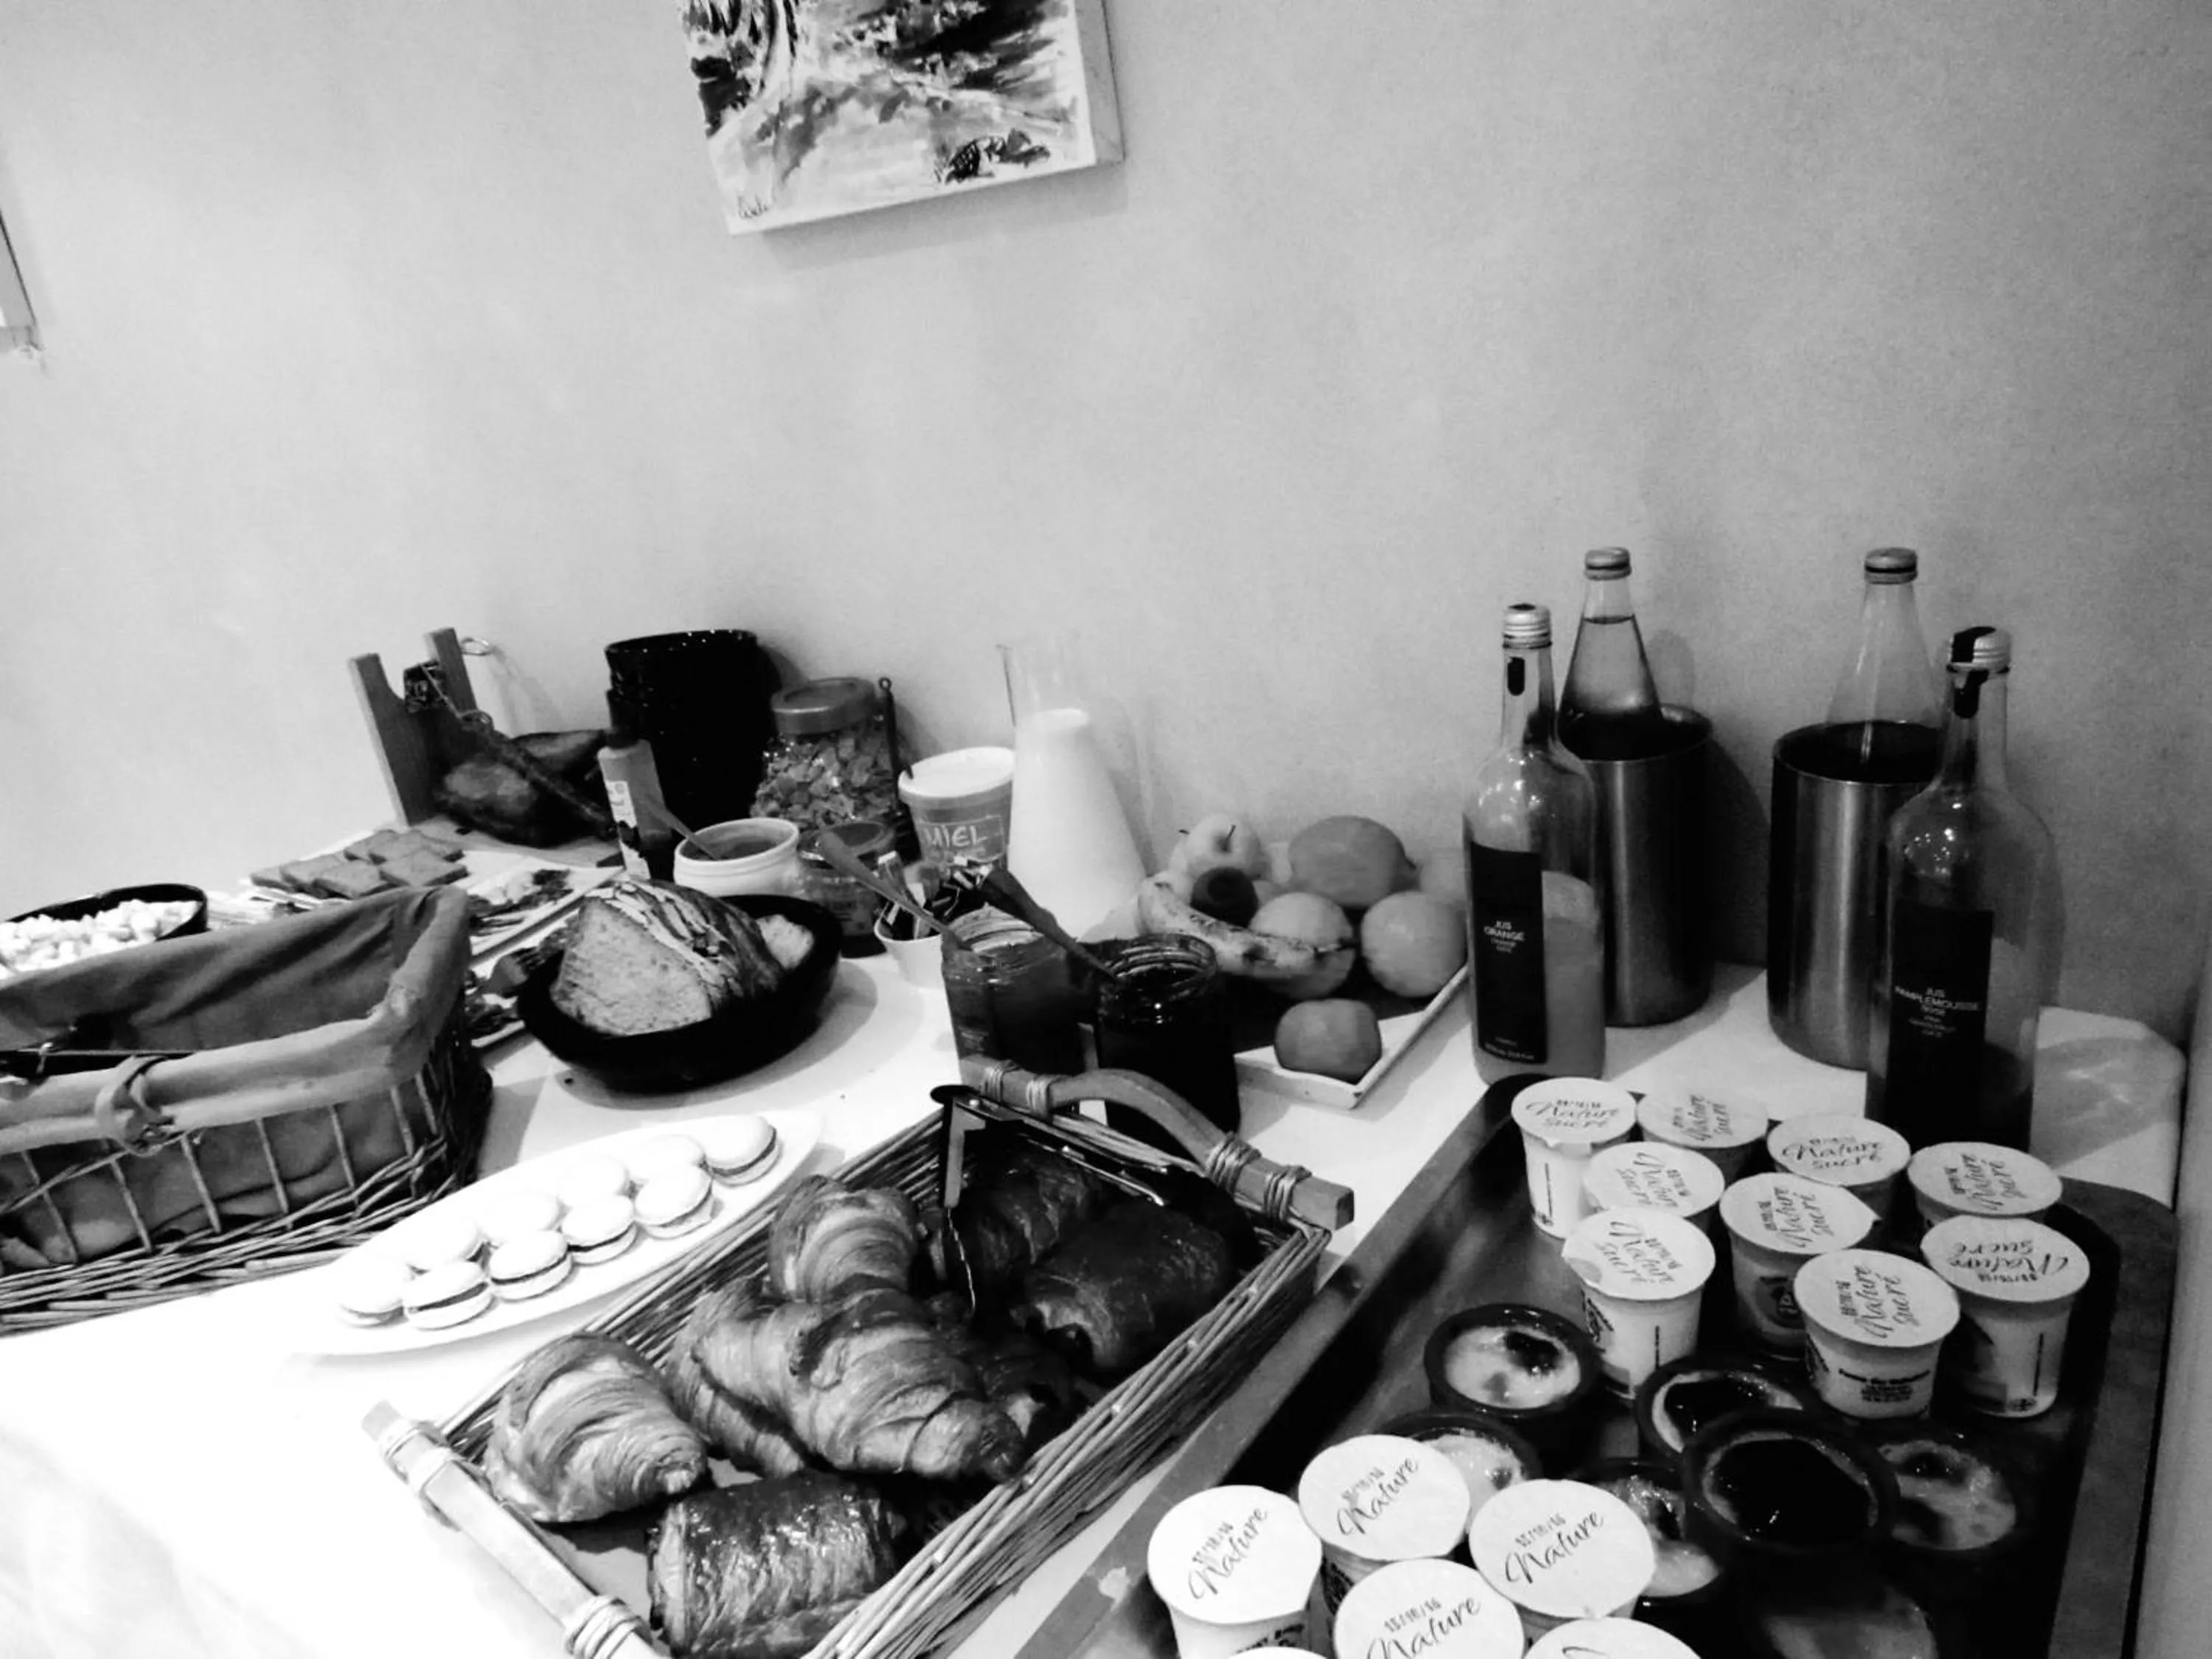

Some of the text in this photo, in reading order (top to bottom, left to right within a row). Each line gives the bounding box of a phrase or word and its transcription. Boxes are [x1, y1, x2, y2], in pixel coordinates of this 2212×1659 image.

[924, 825, 987, 847] MIEL
[1483, 925, 1525, 942] ORANGE
[1781, 1142, 1882, 1161] Nature
[1961, 1153, 2000, 1211] Nature
[1773, 1186, 1815, 1249] Nature
[1852, 1263, 1896, 1340] Nature
[1337, 1457, 1419, 1536] Nature
[1188, 1507, 1268, 1600] Nature
[1505, 1511, 1604, 1585] Nature
[1366, 1596, 1482, 1659] Nature
